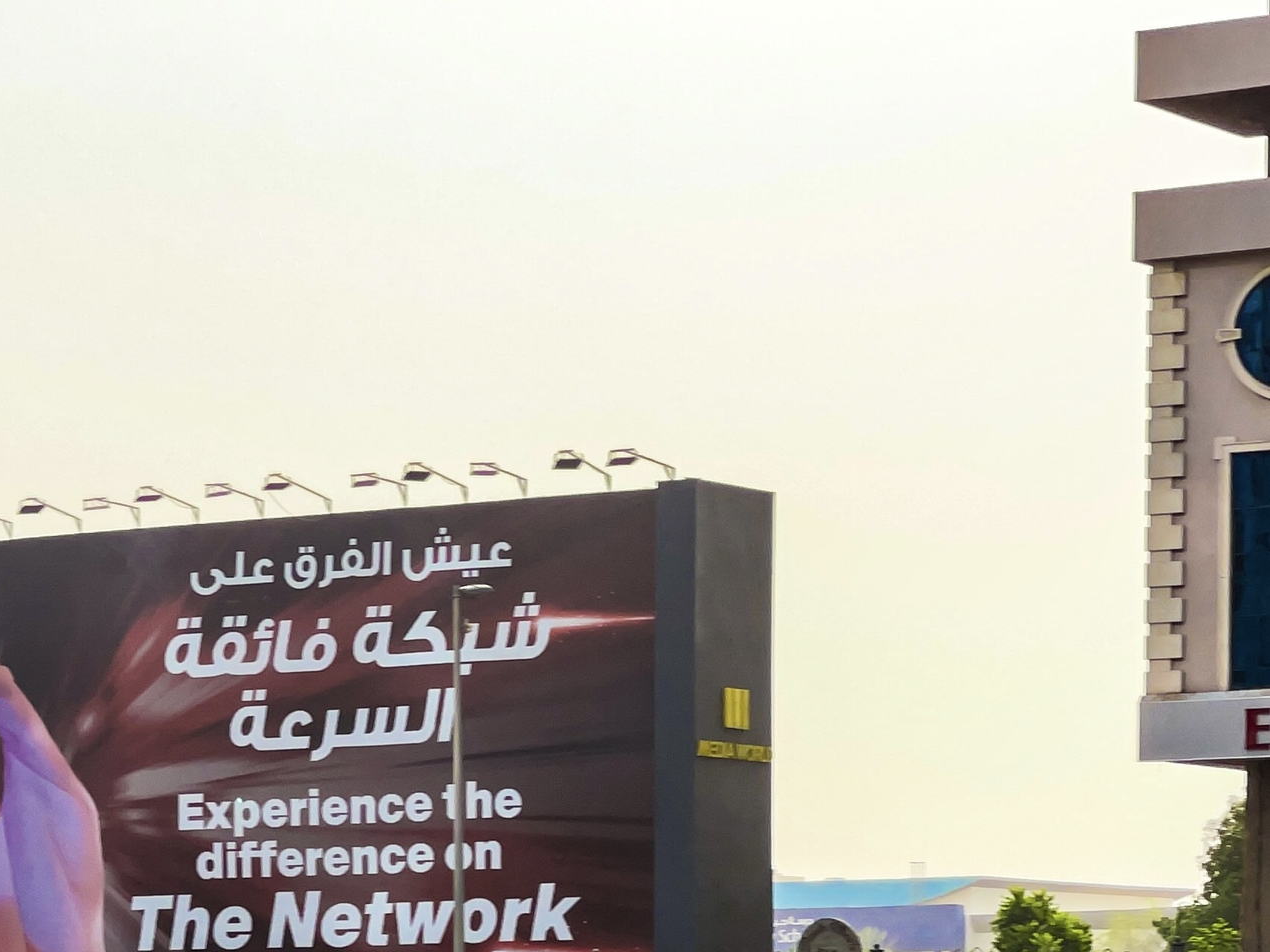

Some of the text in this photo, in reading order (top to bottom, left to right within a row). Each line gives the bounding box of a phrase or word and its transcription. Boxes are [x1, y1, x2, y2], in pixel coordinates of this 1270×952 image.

[189, 528, 512, 595] عيش الفرق على
[164, 592, 552, 678] شبكة فائقة
[229, 687, 455, 761] السرعة
[177, 781, 522, 836] Experience the
[196, 840, 502, 879] difference on
[131, 883, 582, 951] The Network
